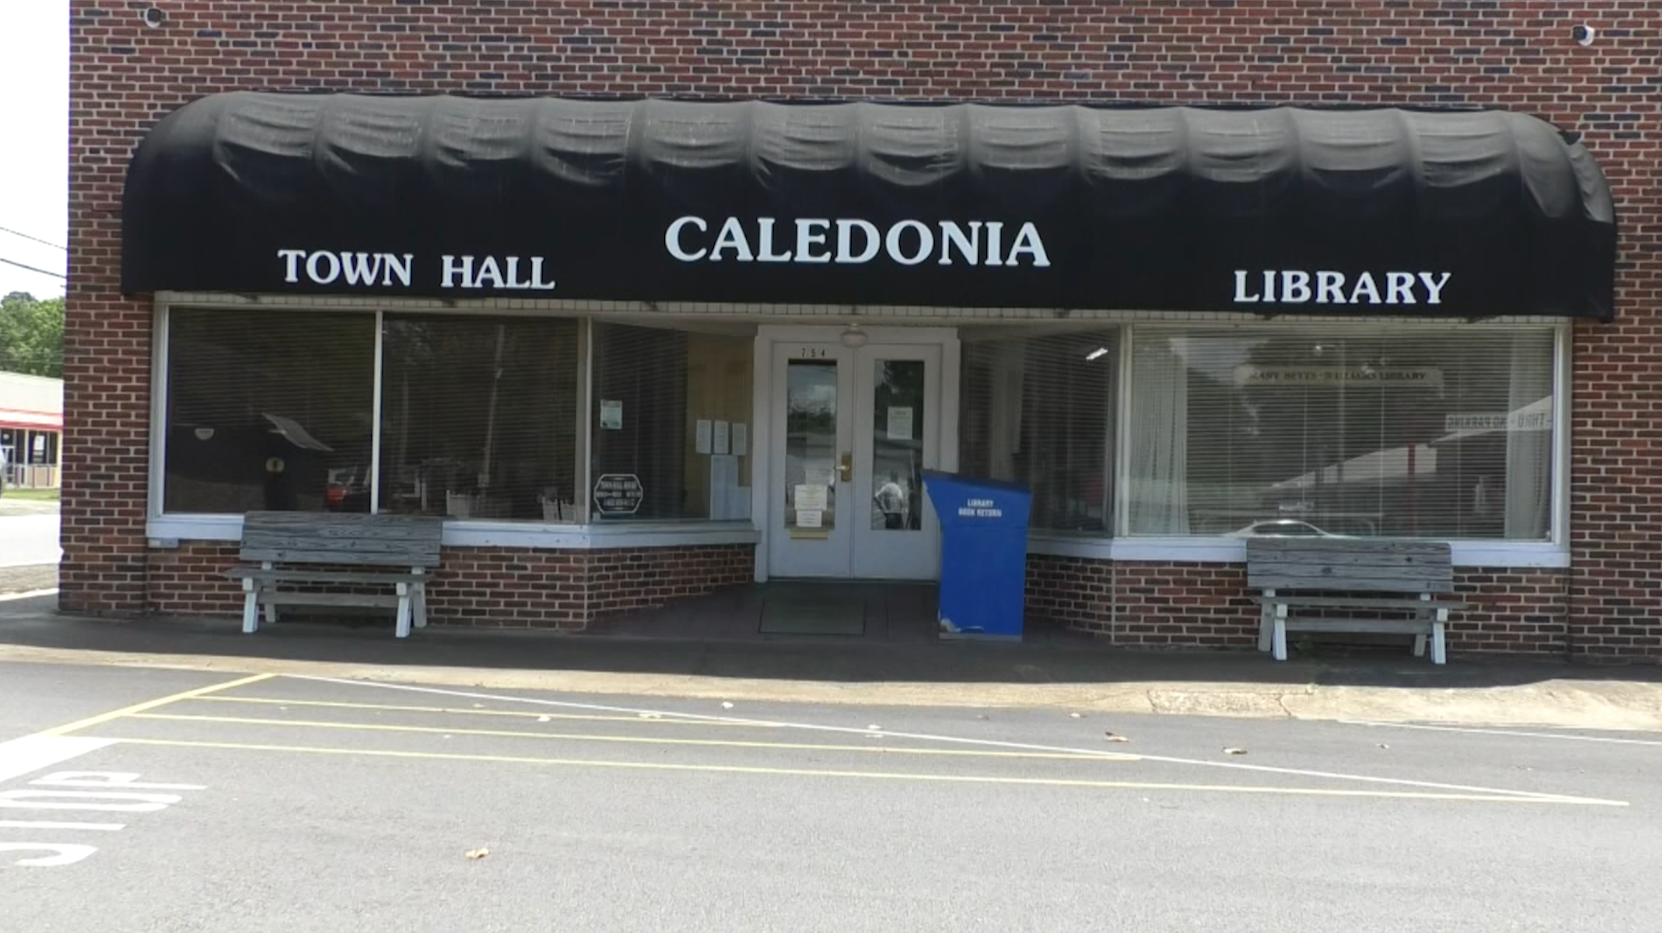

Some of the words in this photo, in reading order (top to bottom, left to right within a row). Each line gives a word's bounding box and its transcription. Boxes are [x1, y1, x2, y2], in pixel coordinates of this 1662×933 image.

[664, 215, 1051, 267] CALEDONIA
[277, 249, 414, 286] TOWN
[440, 255, 556, 290] HALL
[1233, 270, 1452, 304] LIBRARY
[801, 347, 825, 358] 754
[1379, 371, 1426, 381] LIBRARY
[967, 498, 993, 508] LIBRARY
